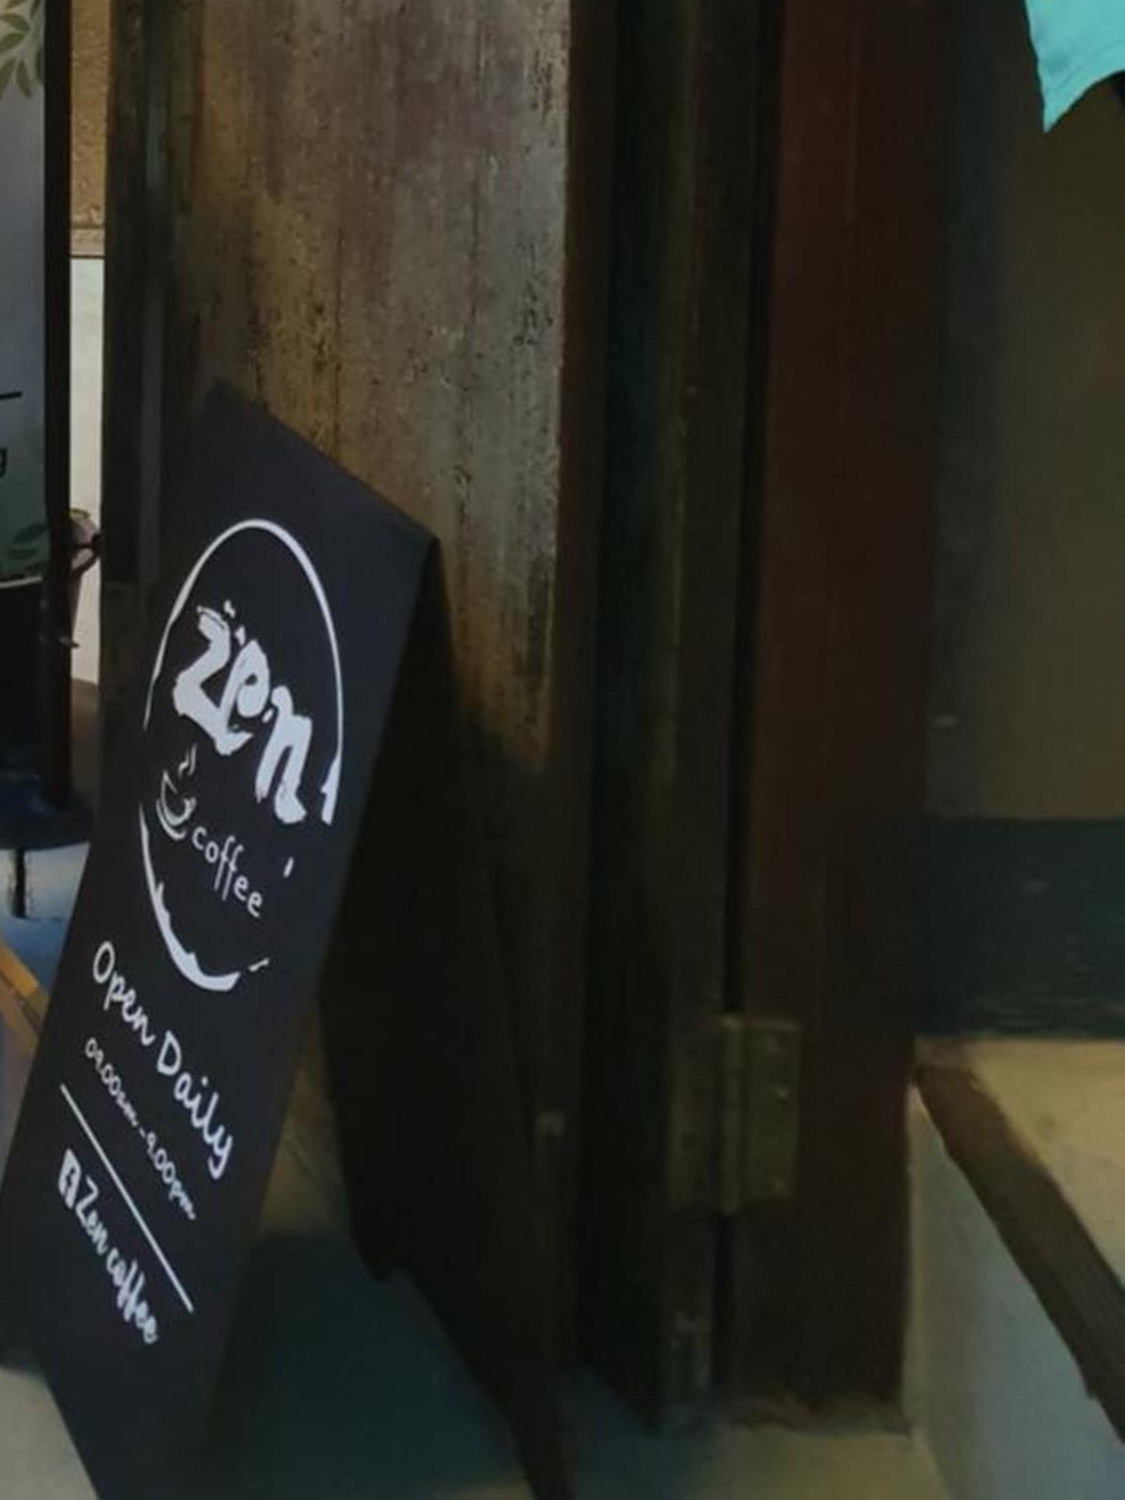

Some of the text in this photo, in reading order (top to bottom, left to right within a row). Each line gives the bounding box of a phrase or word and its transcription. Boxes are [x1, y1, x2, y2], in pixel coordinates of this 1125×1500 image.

[173, 600, 313, 825] Zen
[191, 824, 263, 919] coffee
[92, 941, 233, 1181] Open Daily
